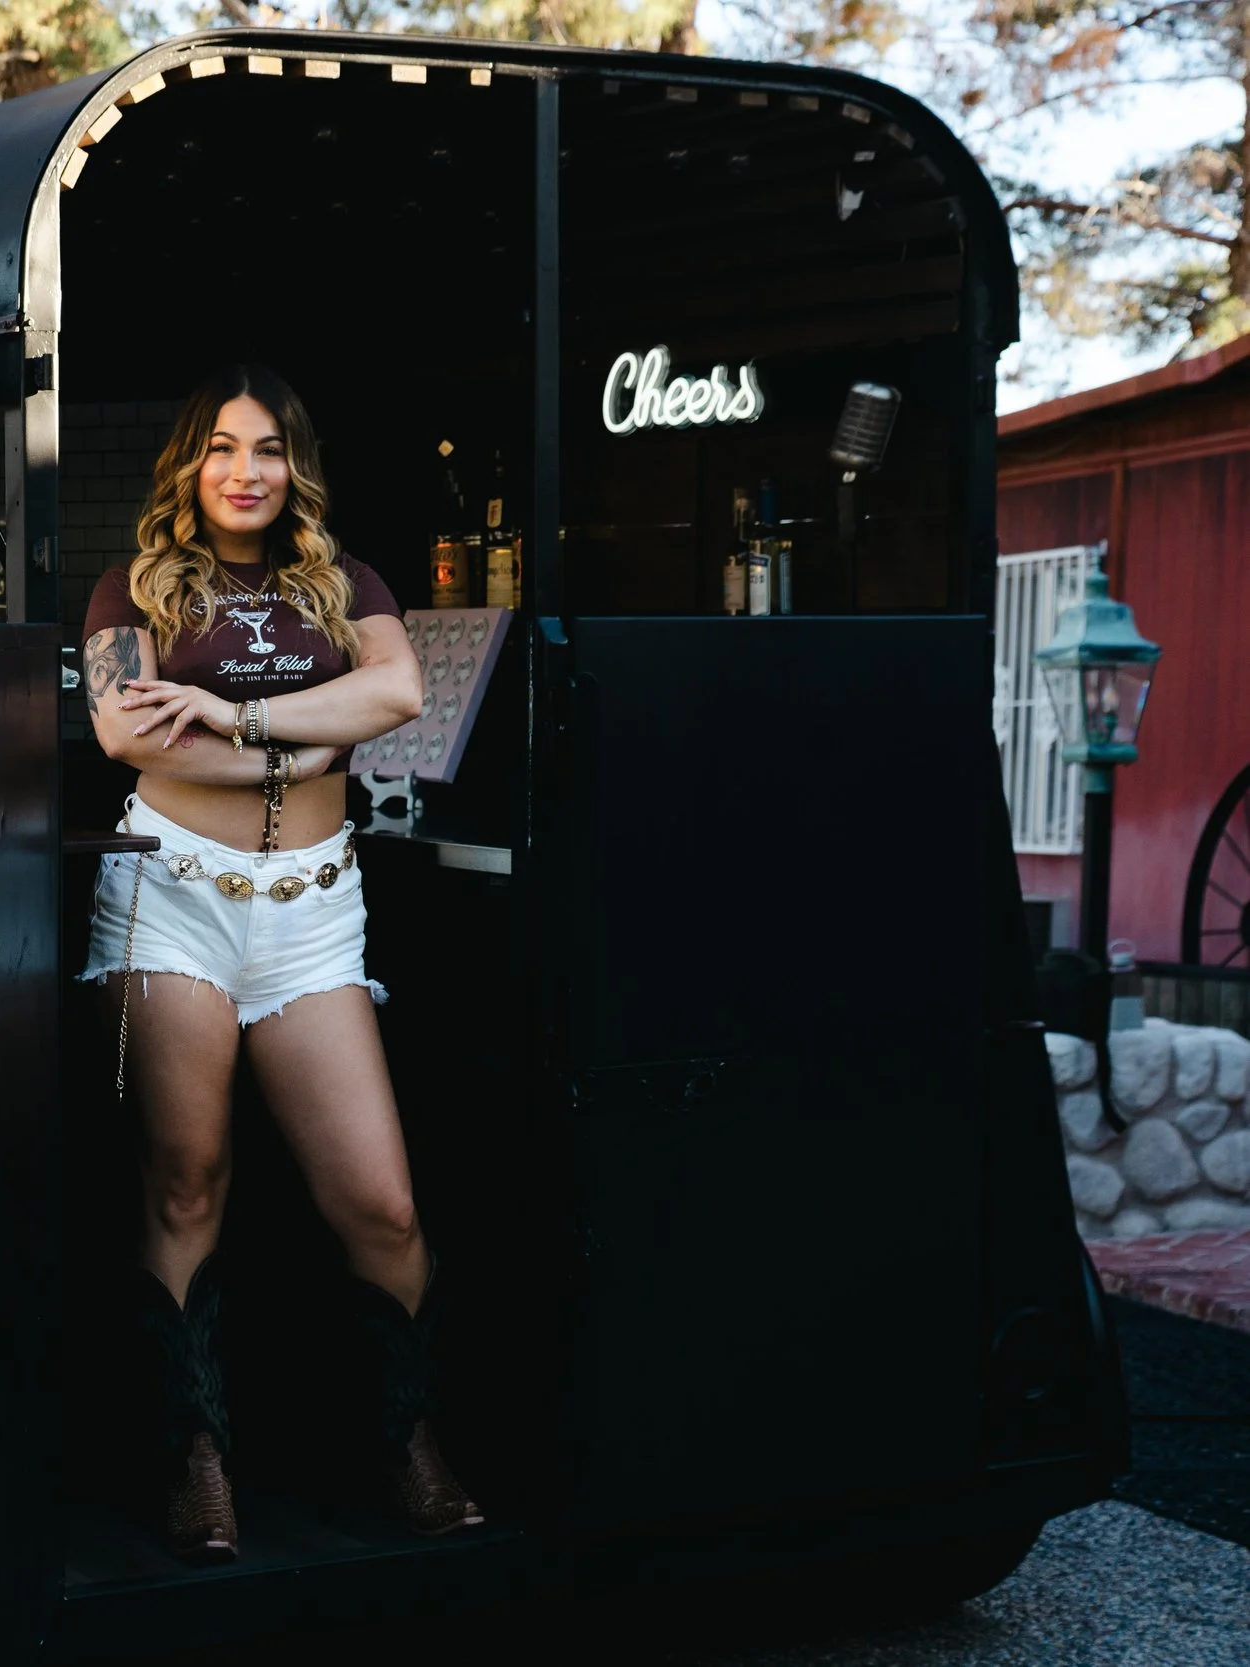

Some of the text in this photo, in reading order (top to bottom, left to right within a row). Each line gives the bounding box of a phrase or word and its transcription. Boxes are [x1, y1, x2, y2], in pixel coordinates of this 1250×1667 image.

[602, 345, 764, 434] Cheers
[216, 654, 314, 675] Social Club
